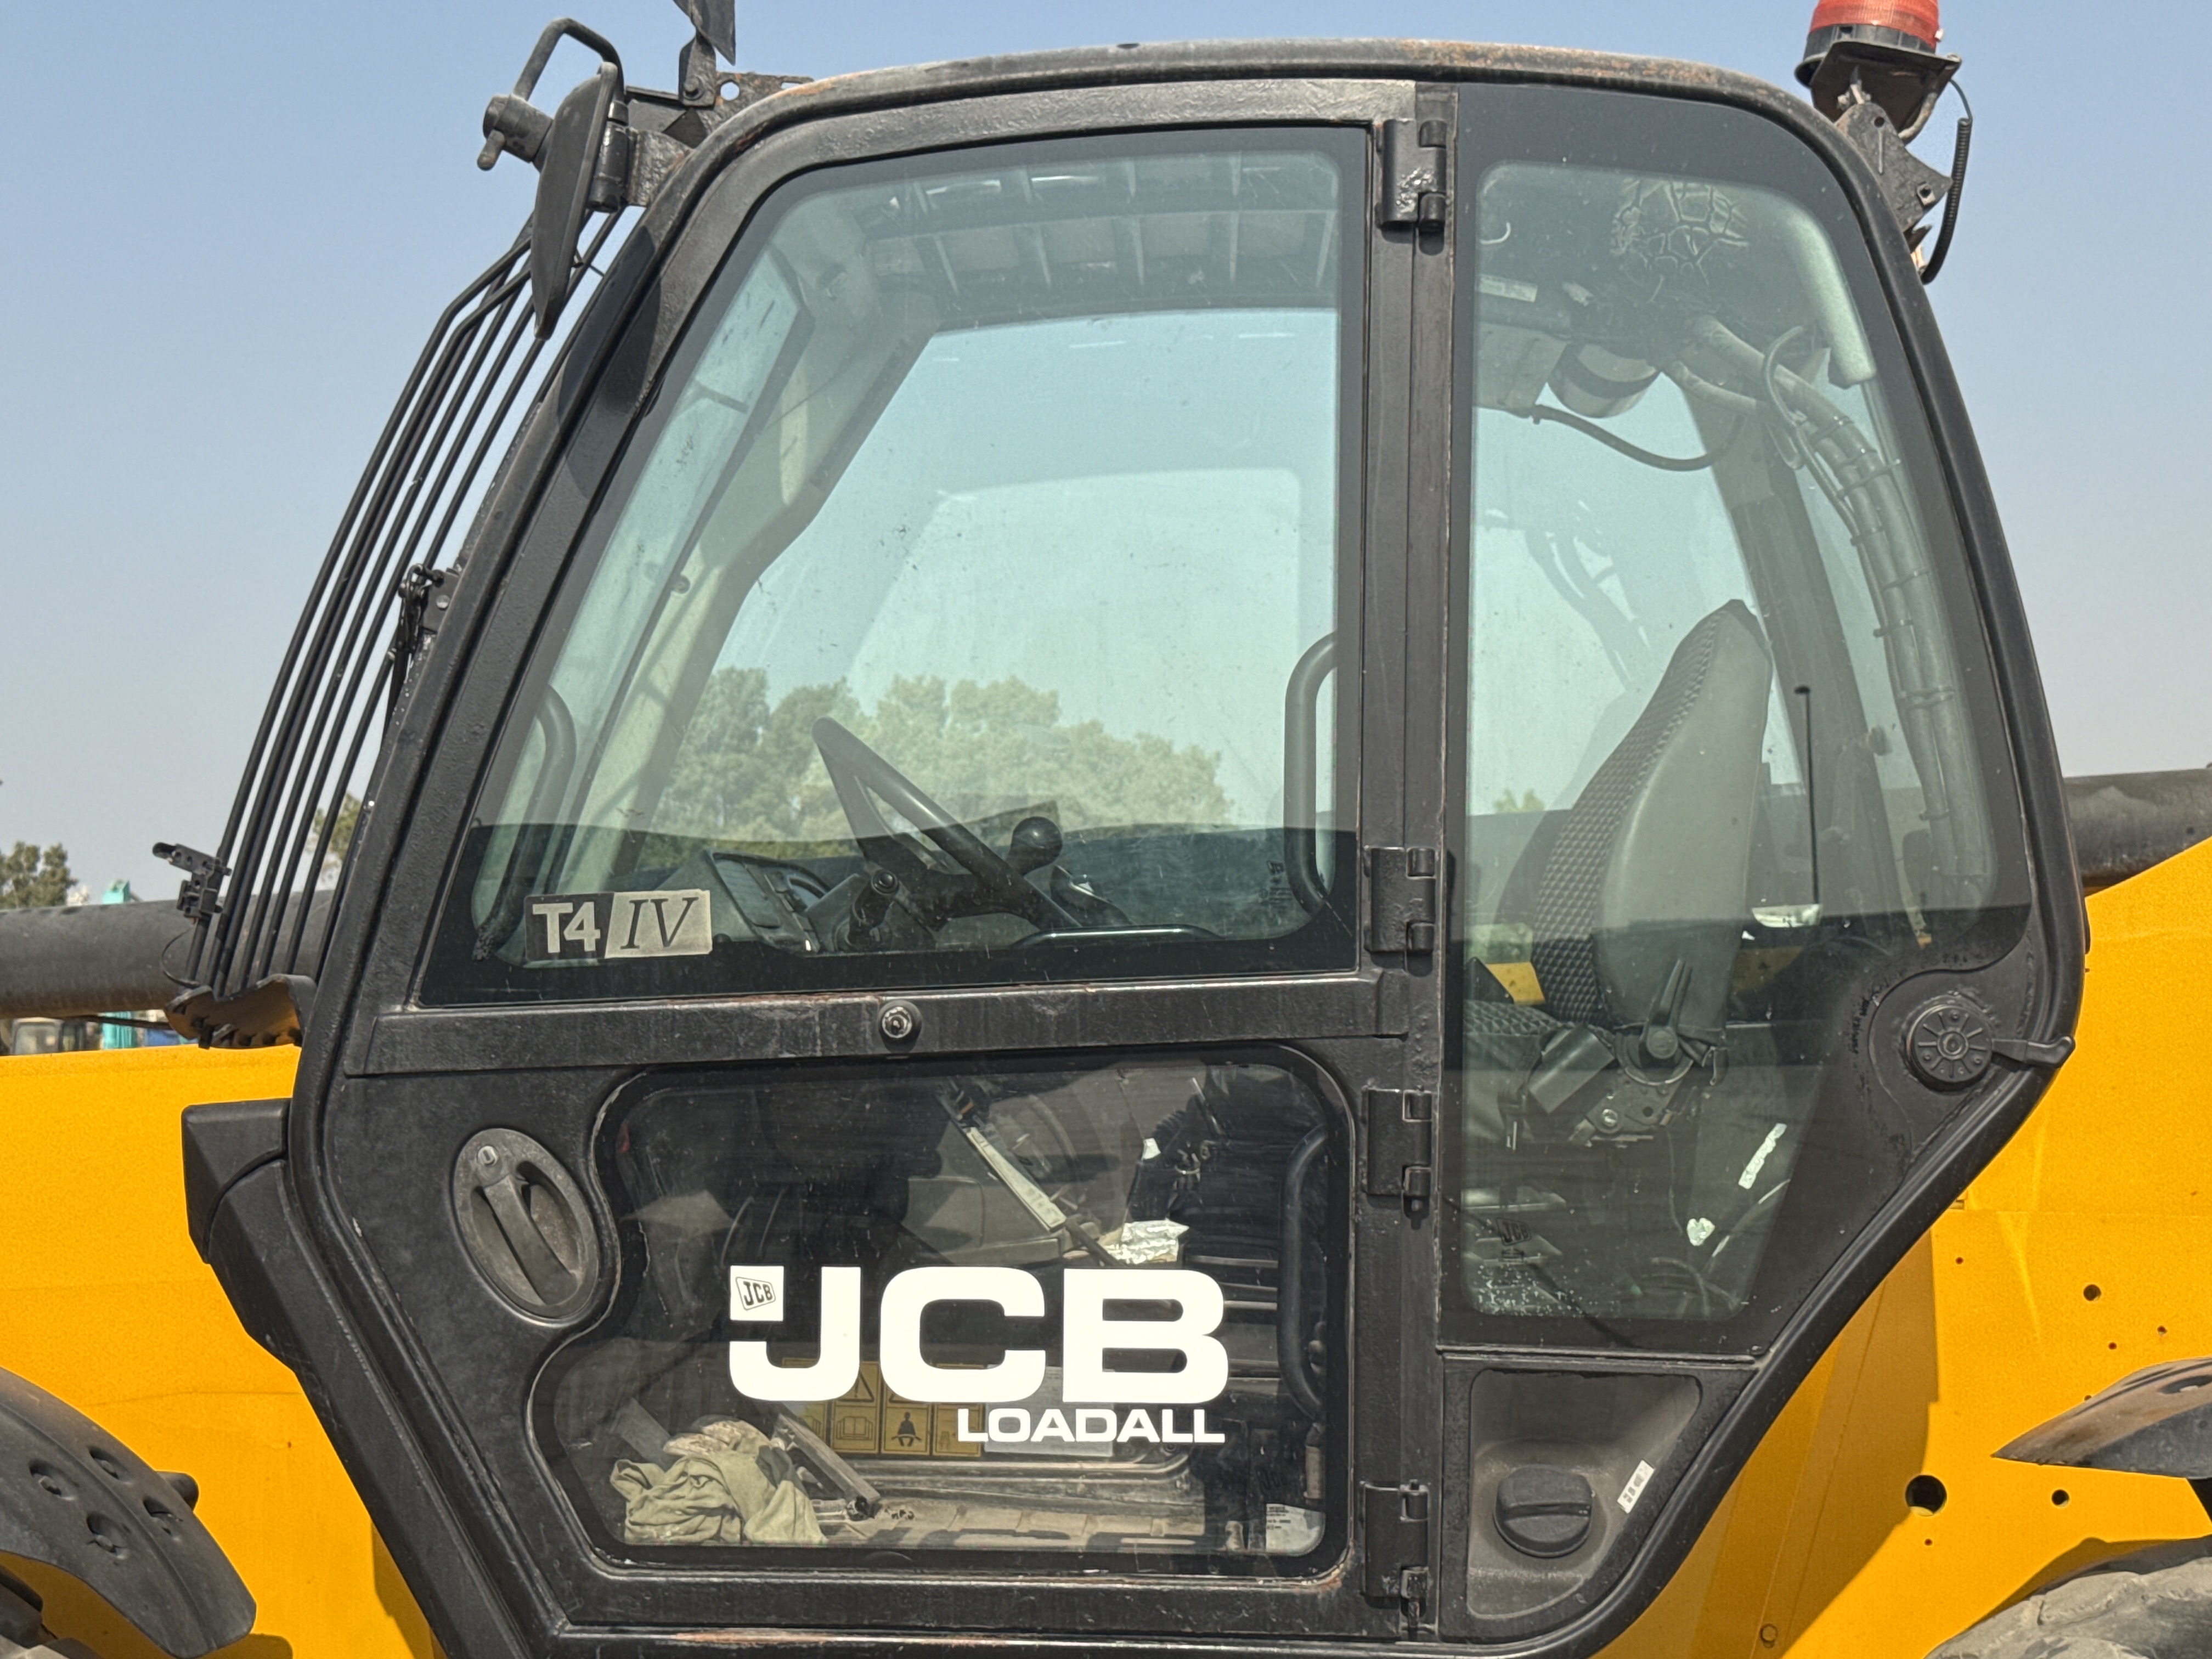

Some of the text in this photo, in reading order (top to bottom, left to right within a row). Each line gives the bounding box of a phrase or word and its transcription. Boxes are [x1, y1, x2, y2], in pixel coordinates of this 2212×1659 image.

[532, 896, 699, 953] T4 IV
[1502, 1221, 1529, 1243] JCB
[743, 1280, 773, 1306] JCB
[730, 1265, 1229, 1404] JCB
[957, 1408, 1225, 1443] LOADALL
